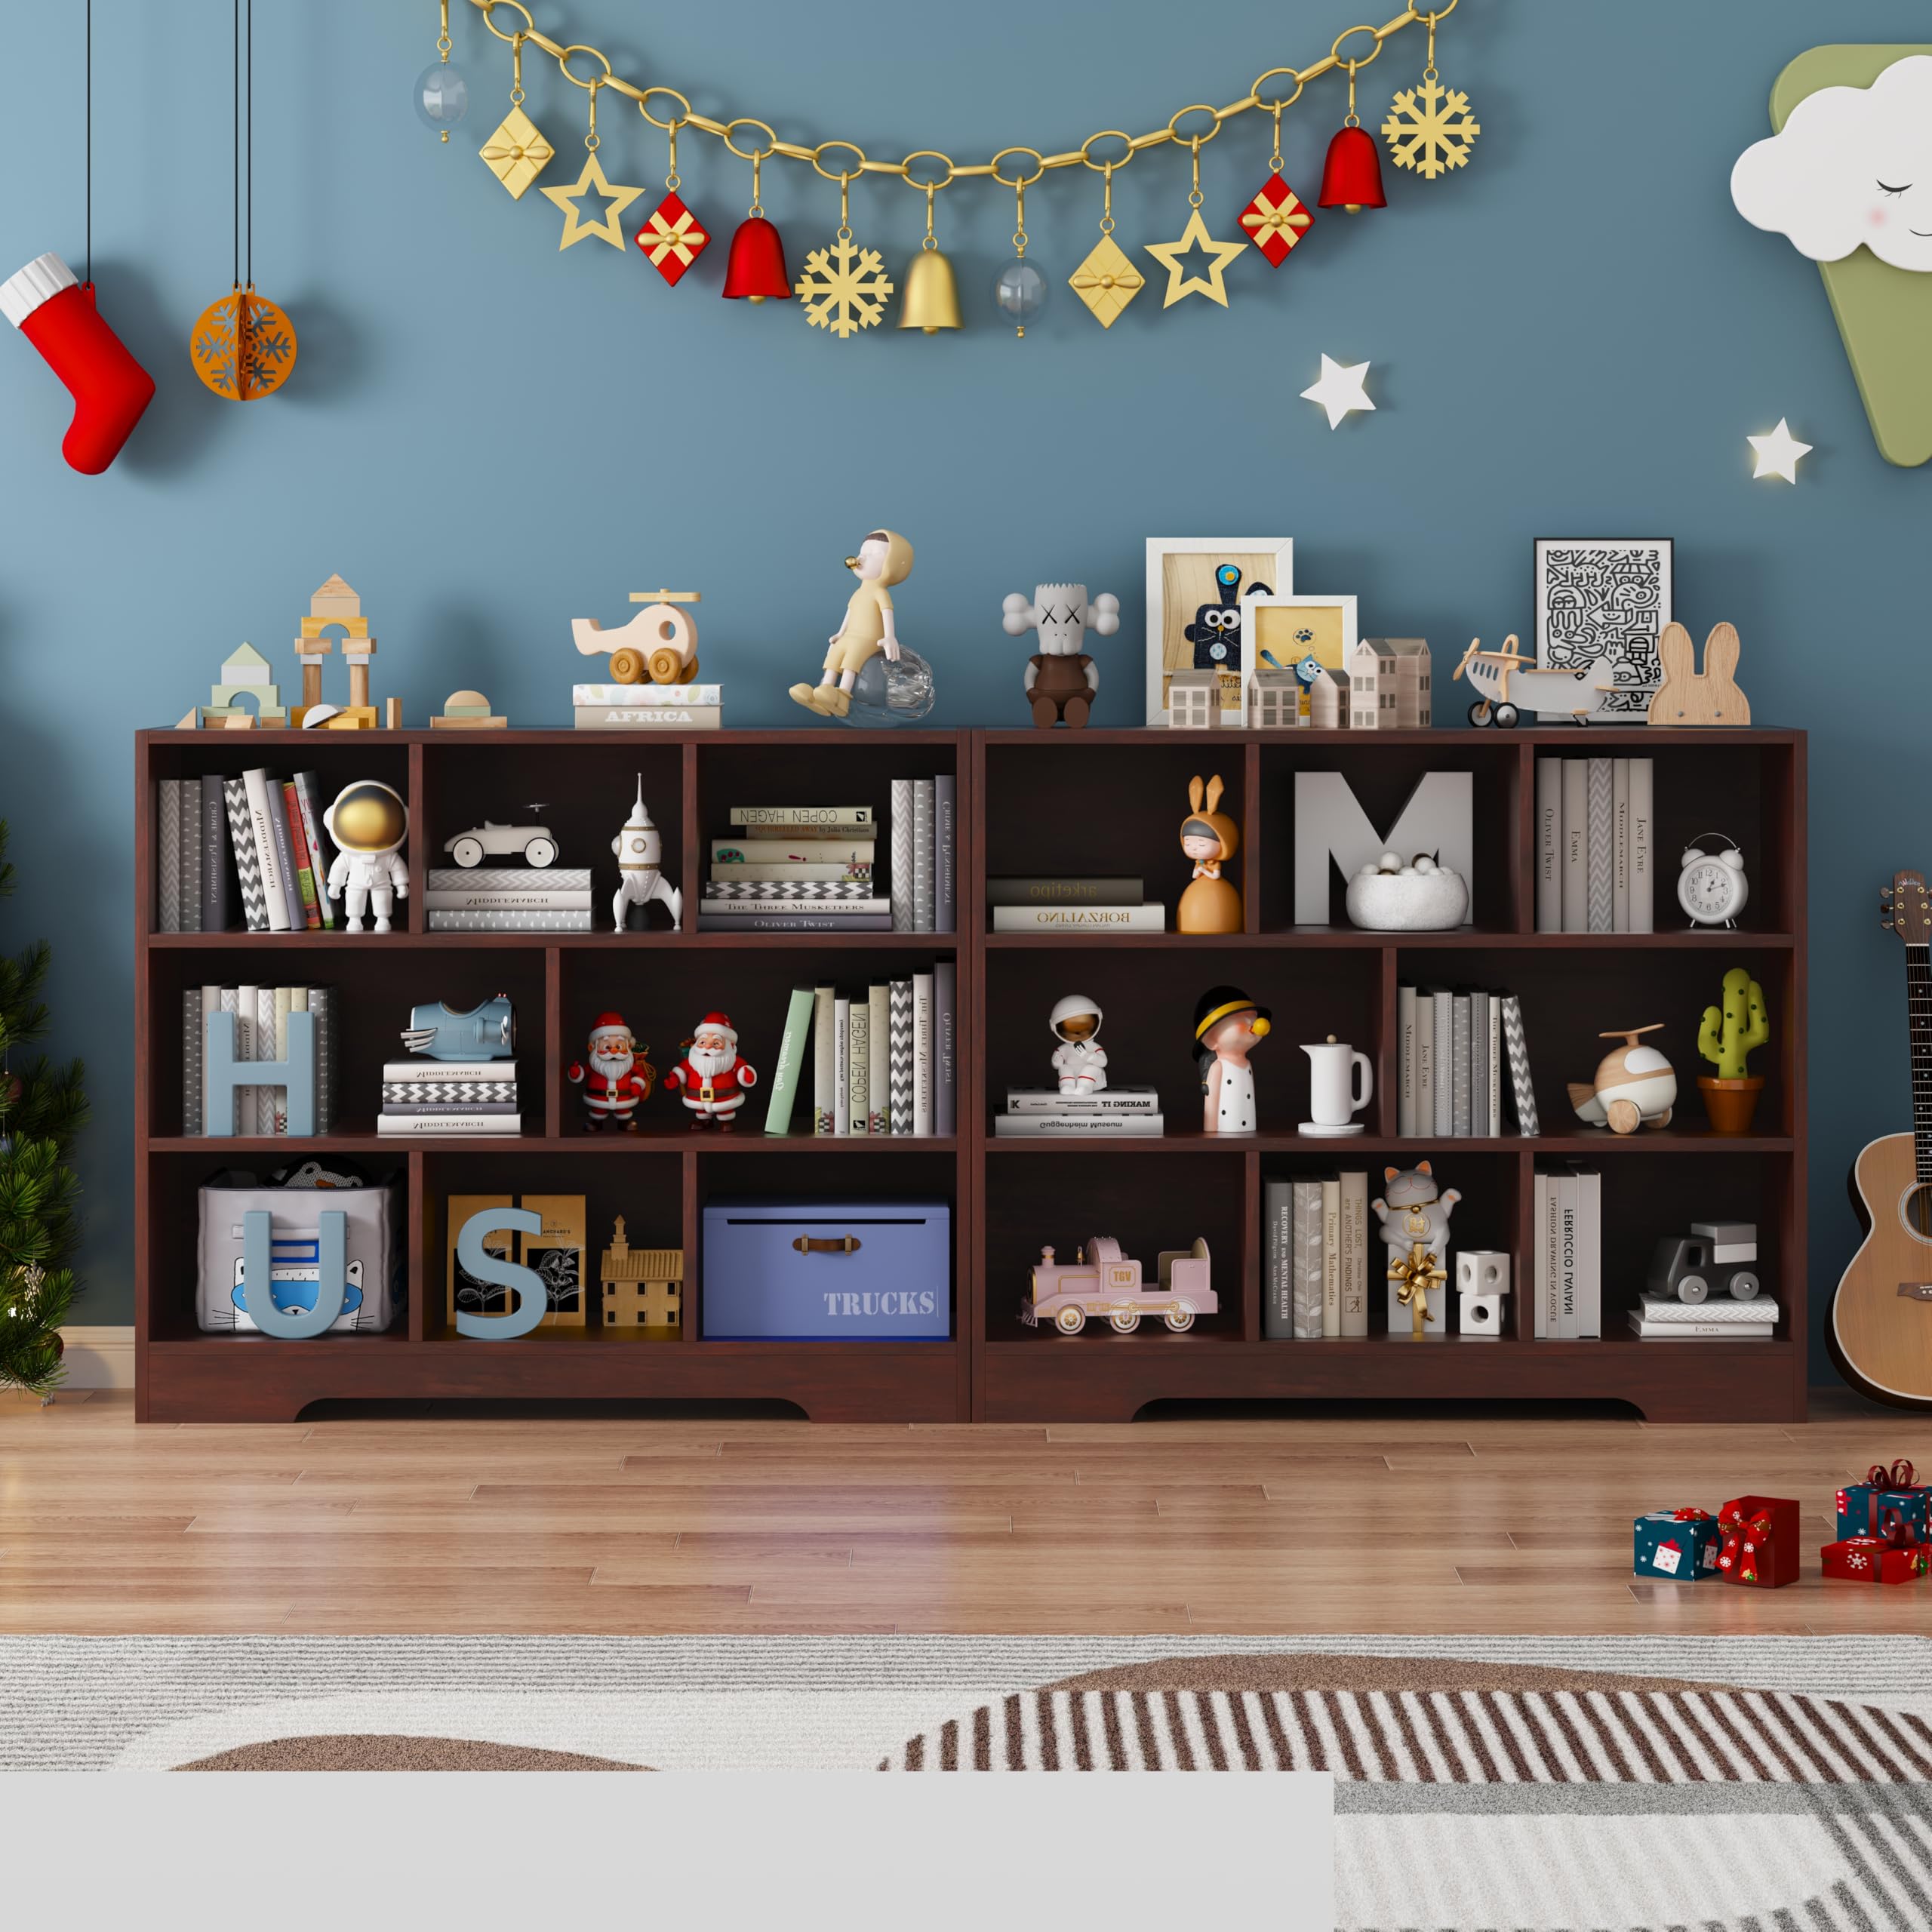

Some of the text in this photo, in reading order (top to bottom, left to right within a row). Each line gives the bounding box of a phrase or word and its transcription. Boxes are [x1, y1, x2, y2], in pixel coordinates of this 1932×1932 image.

[605, 711, 693, 722] AFRICA
[740, 810, 838, 823] COPEN HAGEN
[1571, 831, 1580, 863] EMMA
[1637, 817, 1647, 873] JANE EYRE
[208, 1011, 315, 1137] H
[245, 1211, 347, 1338] U
[457, 1208, 547, 1339] S
[1113, 1271, 1131, 1281] TGV
[1327, 1212, 1337, 1306] Primary Mathematics
[823, 1291, 934, 1315] TRUCKS
